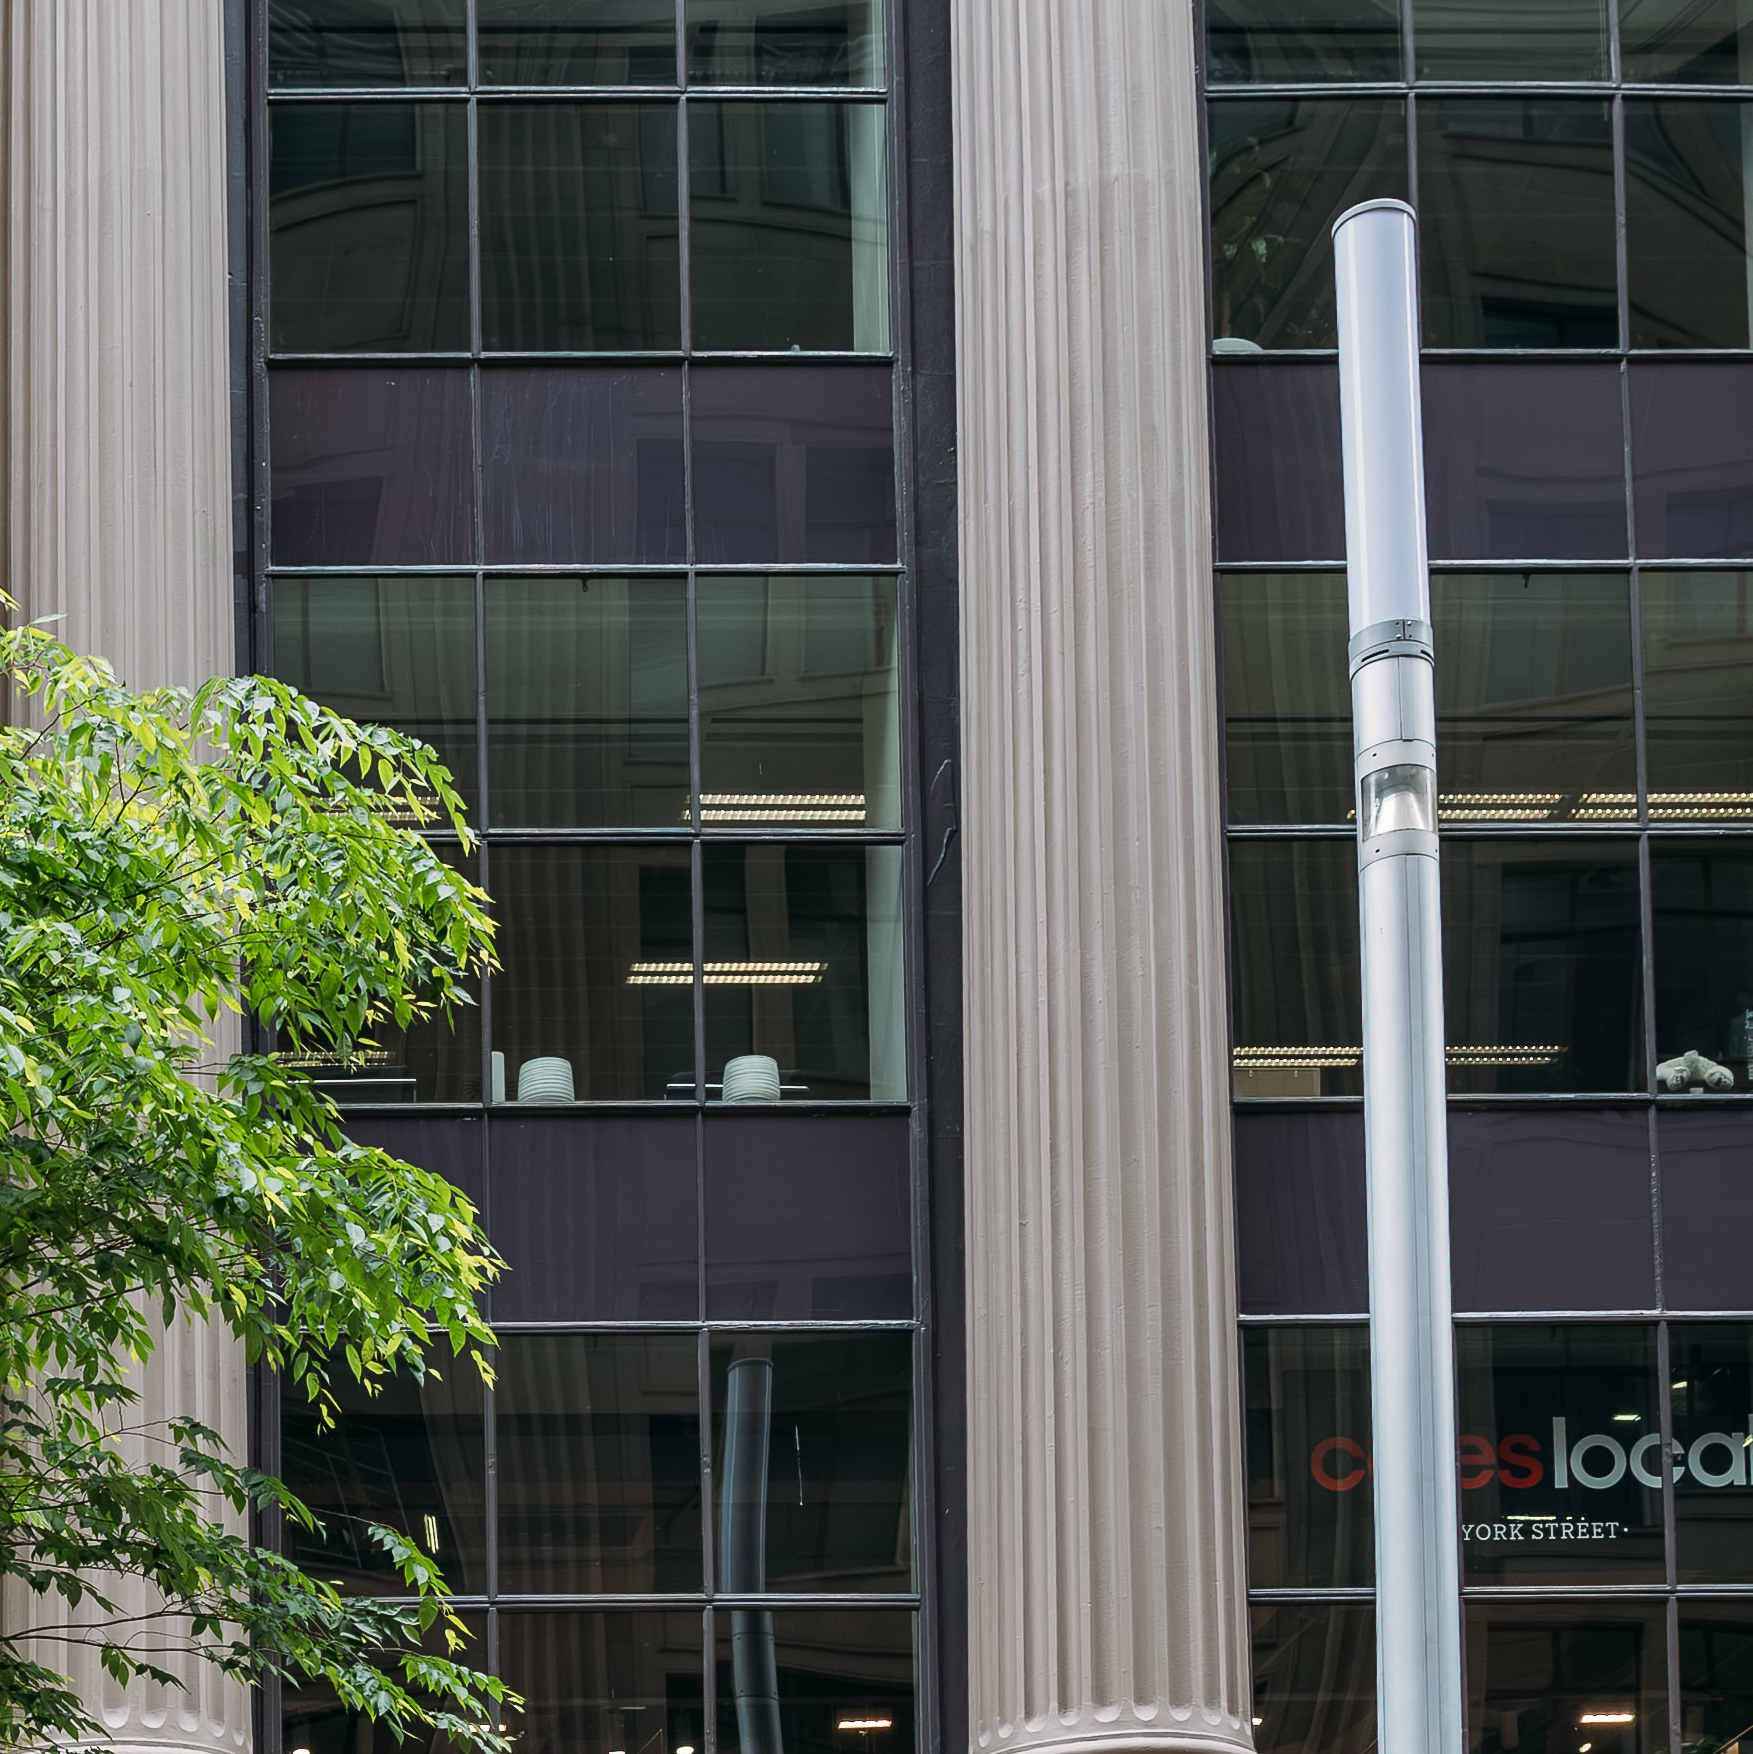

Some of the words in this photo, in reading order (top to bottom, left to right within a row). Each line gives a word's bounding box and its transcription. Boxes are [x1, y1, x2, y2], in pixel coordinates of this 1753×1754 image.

[1310, 1434, 1544, 1493] ces
[1552, 1415, 1753, 1490] loca
[1461, 1522, 1525, 1541] YORK
[1531, 1522, 1620, 1541] STREET
